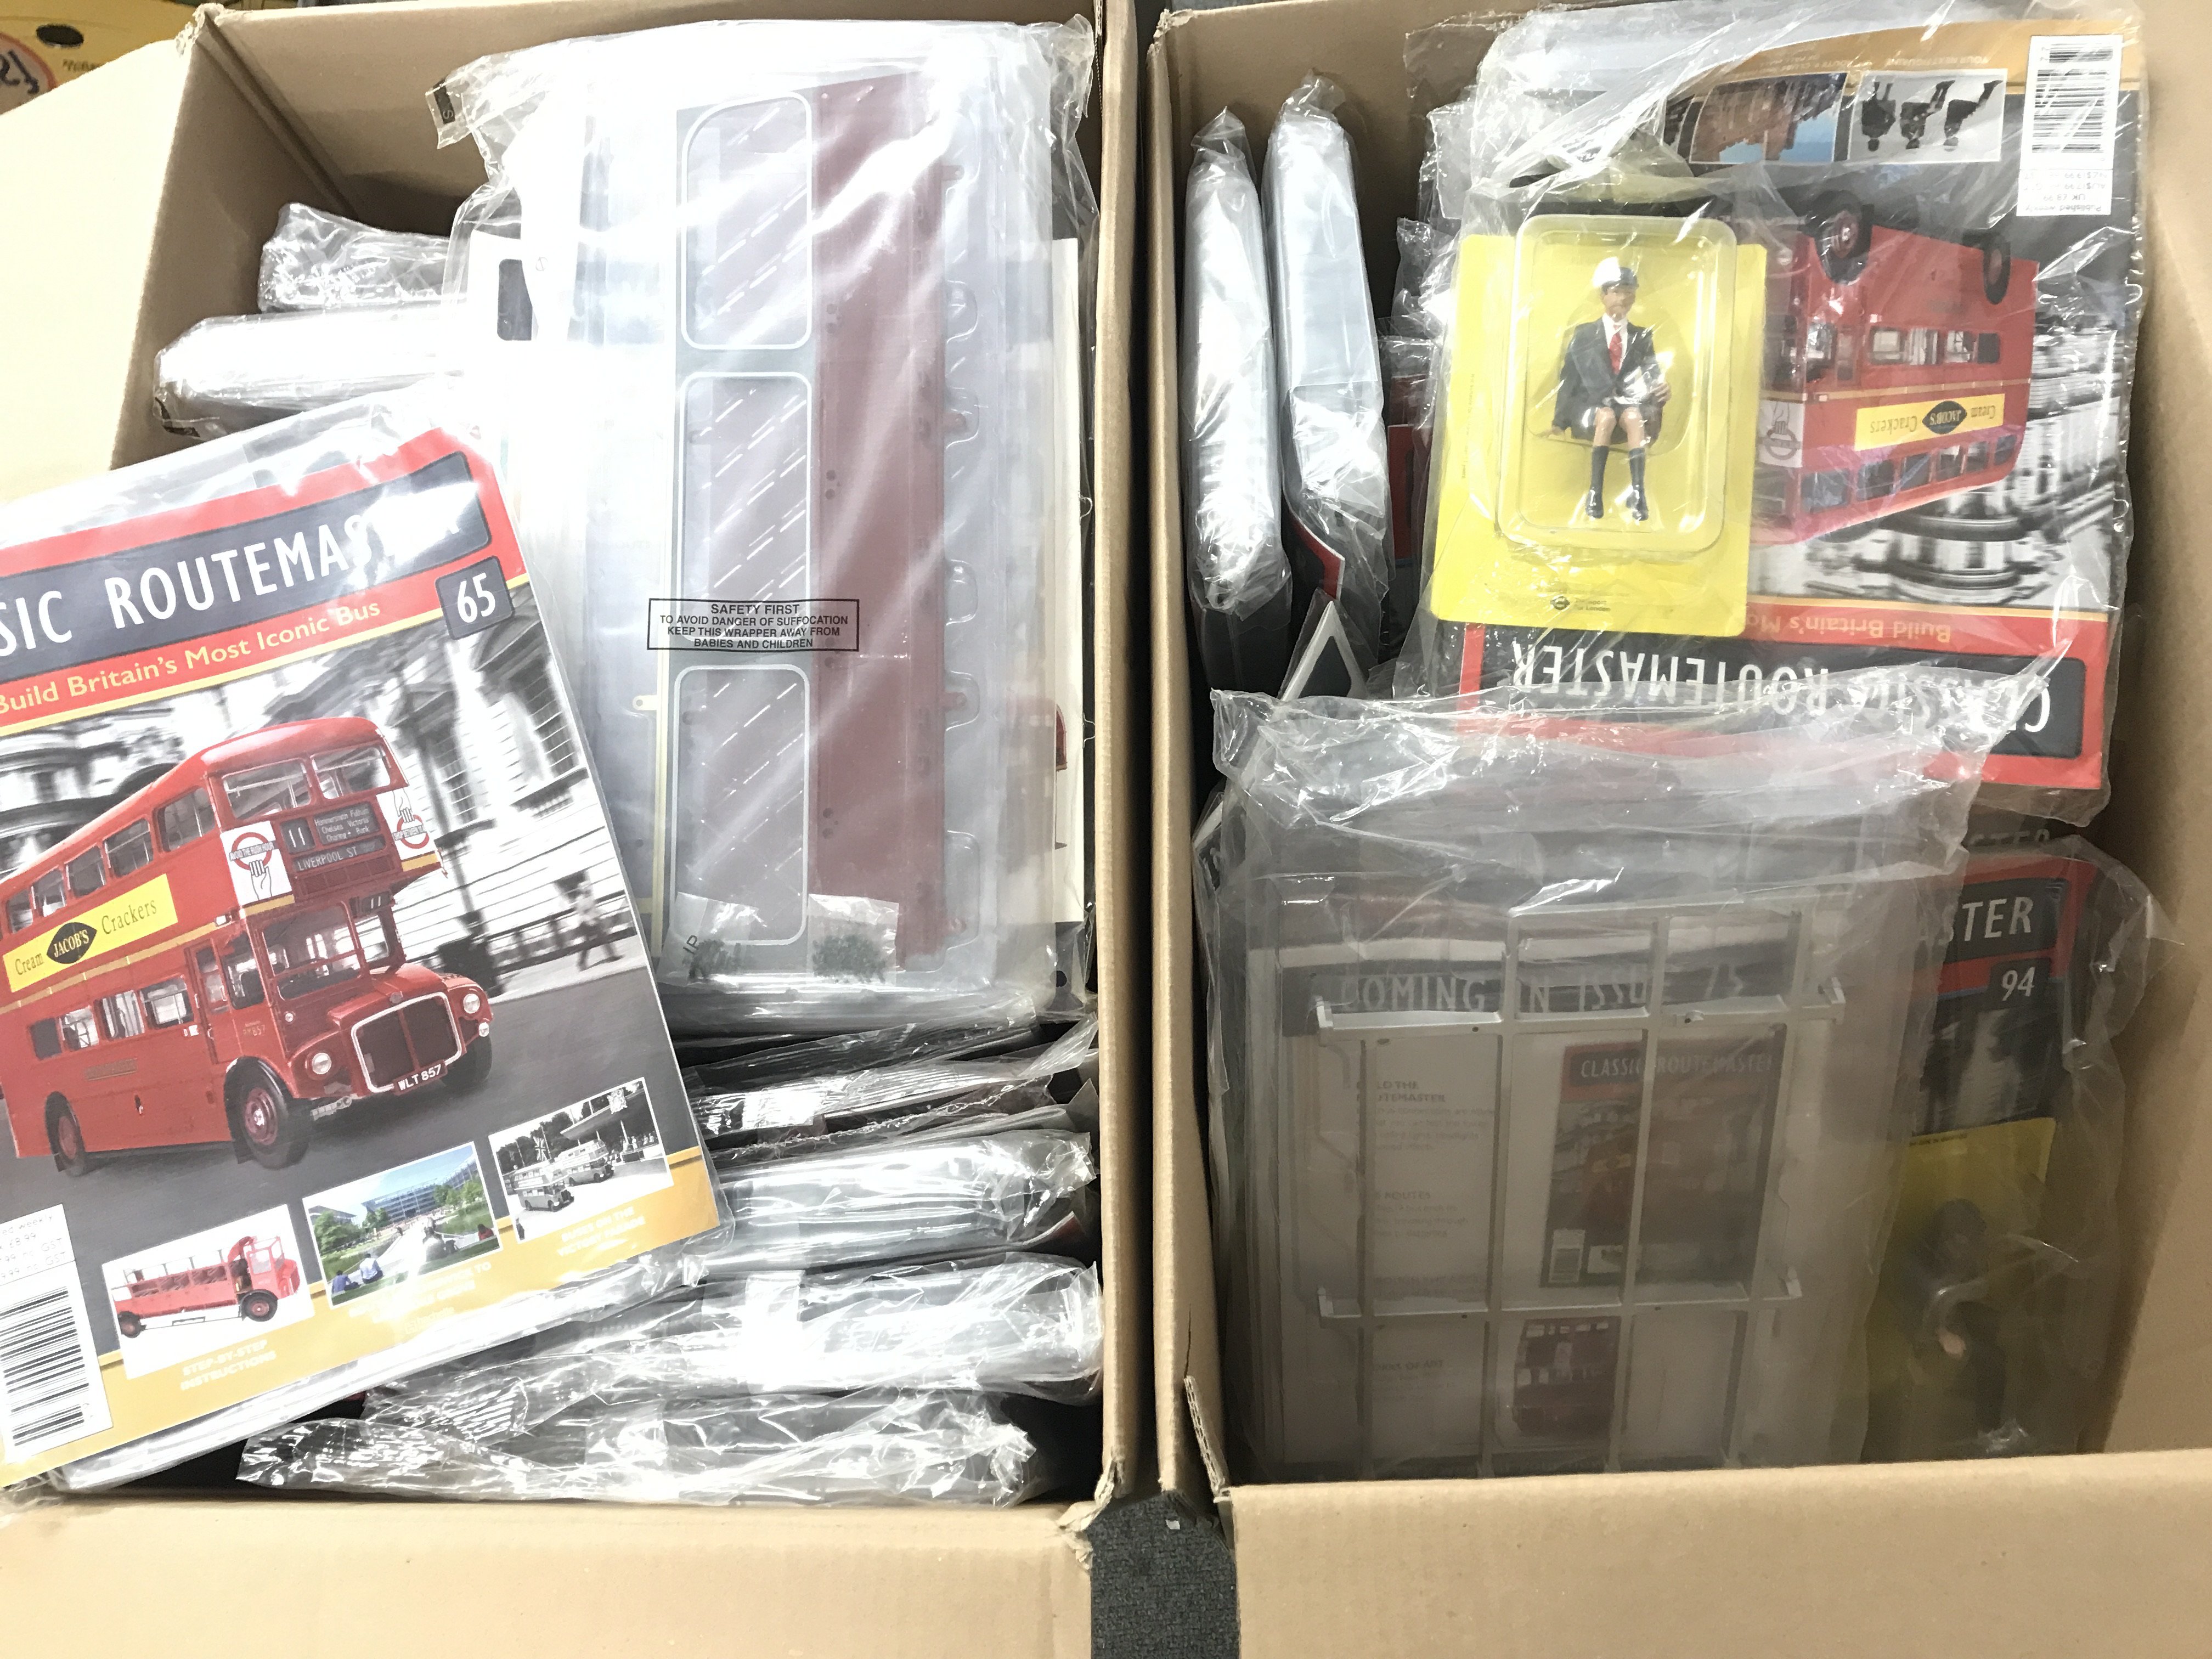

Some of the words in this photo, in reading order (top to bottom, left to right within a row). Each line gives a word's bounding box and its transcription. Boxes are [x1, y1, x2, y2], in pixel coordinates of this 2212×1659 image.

[1870, 415, 1917, 435] Crackers
[104, 496, 460, 630] ROUTEMAS
[456, 572, 496, 624] 65
[710, 604, 760, 615] SAFETY
[765, 604, 800, 614] FIRST
[660, 615, 674, 624] TO
[677, 616, 709, 625] AVOID
[712, 616, 757, 626] DANGER
[759, 616, 775, 626] OF
[777, 615, 849, 626] SUFFOCATION
[668, 626, 696, 636] KEEP
[698, 627, 721, 636] THIS
[724, 627, 777, 637] WRAPPER
[780, 627, 806, 637] AWAY
[810, 627, 840, 636] FROM
[1790, 615, 1884, 638] Britain's
[1892, 620, 1951, 644] Build
[67, 657, 178, 697] Britain's
[184, 639, 251, 669] Most
[256, 617, 330, 650] Iconic
[335, 603, 381, 626] Bus
[694, 639, 733, 648] BABIES
[737, 639, 759, 648] AND
[762, 638, 813, 649] CHILDREN
[1513, 643, 1829, 715] ROUTEMASTER
[289, 826, 306, 848] 11
[297, 852, 343, 871] LIVERPOOL
[348, 847, 358, 857] ST
[371, 896, 381, 909] 11
[15, 952, 44, 975] Cream
[53, 929, 89, 958] JACOB'S
[101, 899, 157, 935] Crackers
[1578, 965, 1651, 1012] ISSU
[2002, 966, 2036, 1002] 94
[397, 1074, 420, 1091] WLT
[421, 1064, 442, 1081] 857
[9, 1232, 36, 1249] £899
[46, 1251, 66, 1265] GST
[473, 1261, 492, 1274] TO
[182, 1339, 268, 1376] STEP-BY-STEP
[180, 1350, 276, 1391] INSTRUCTIONS
